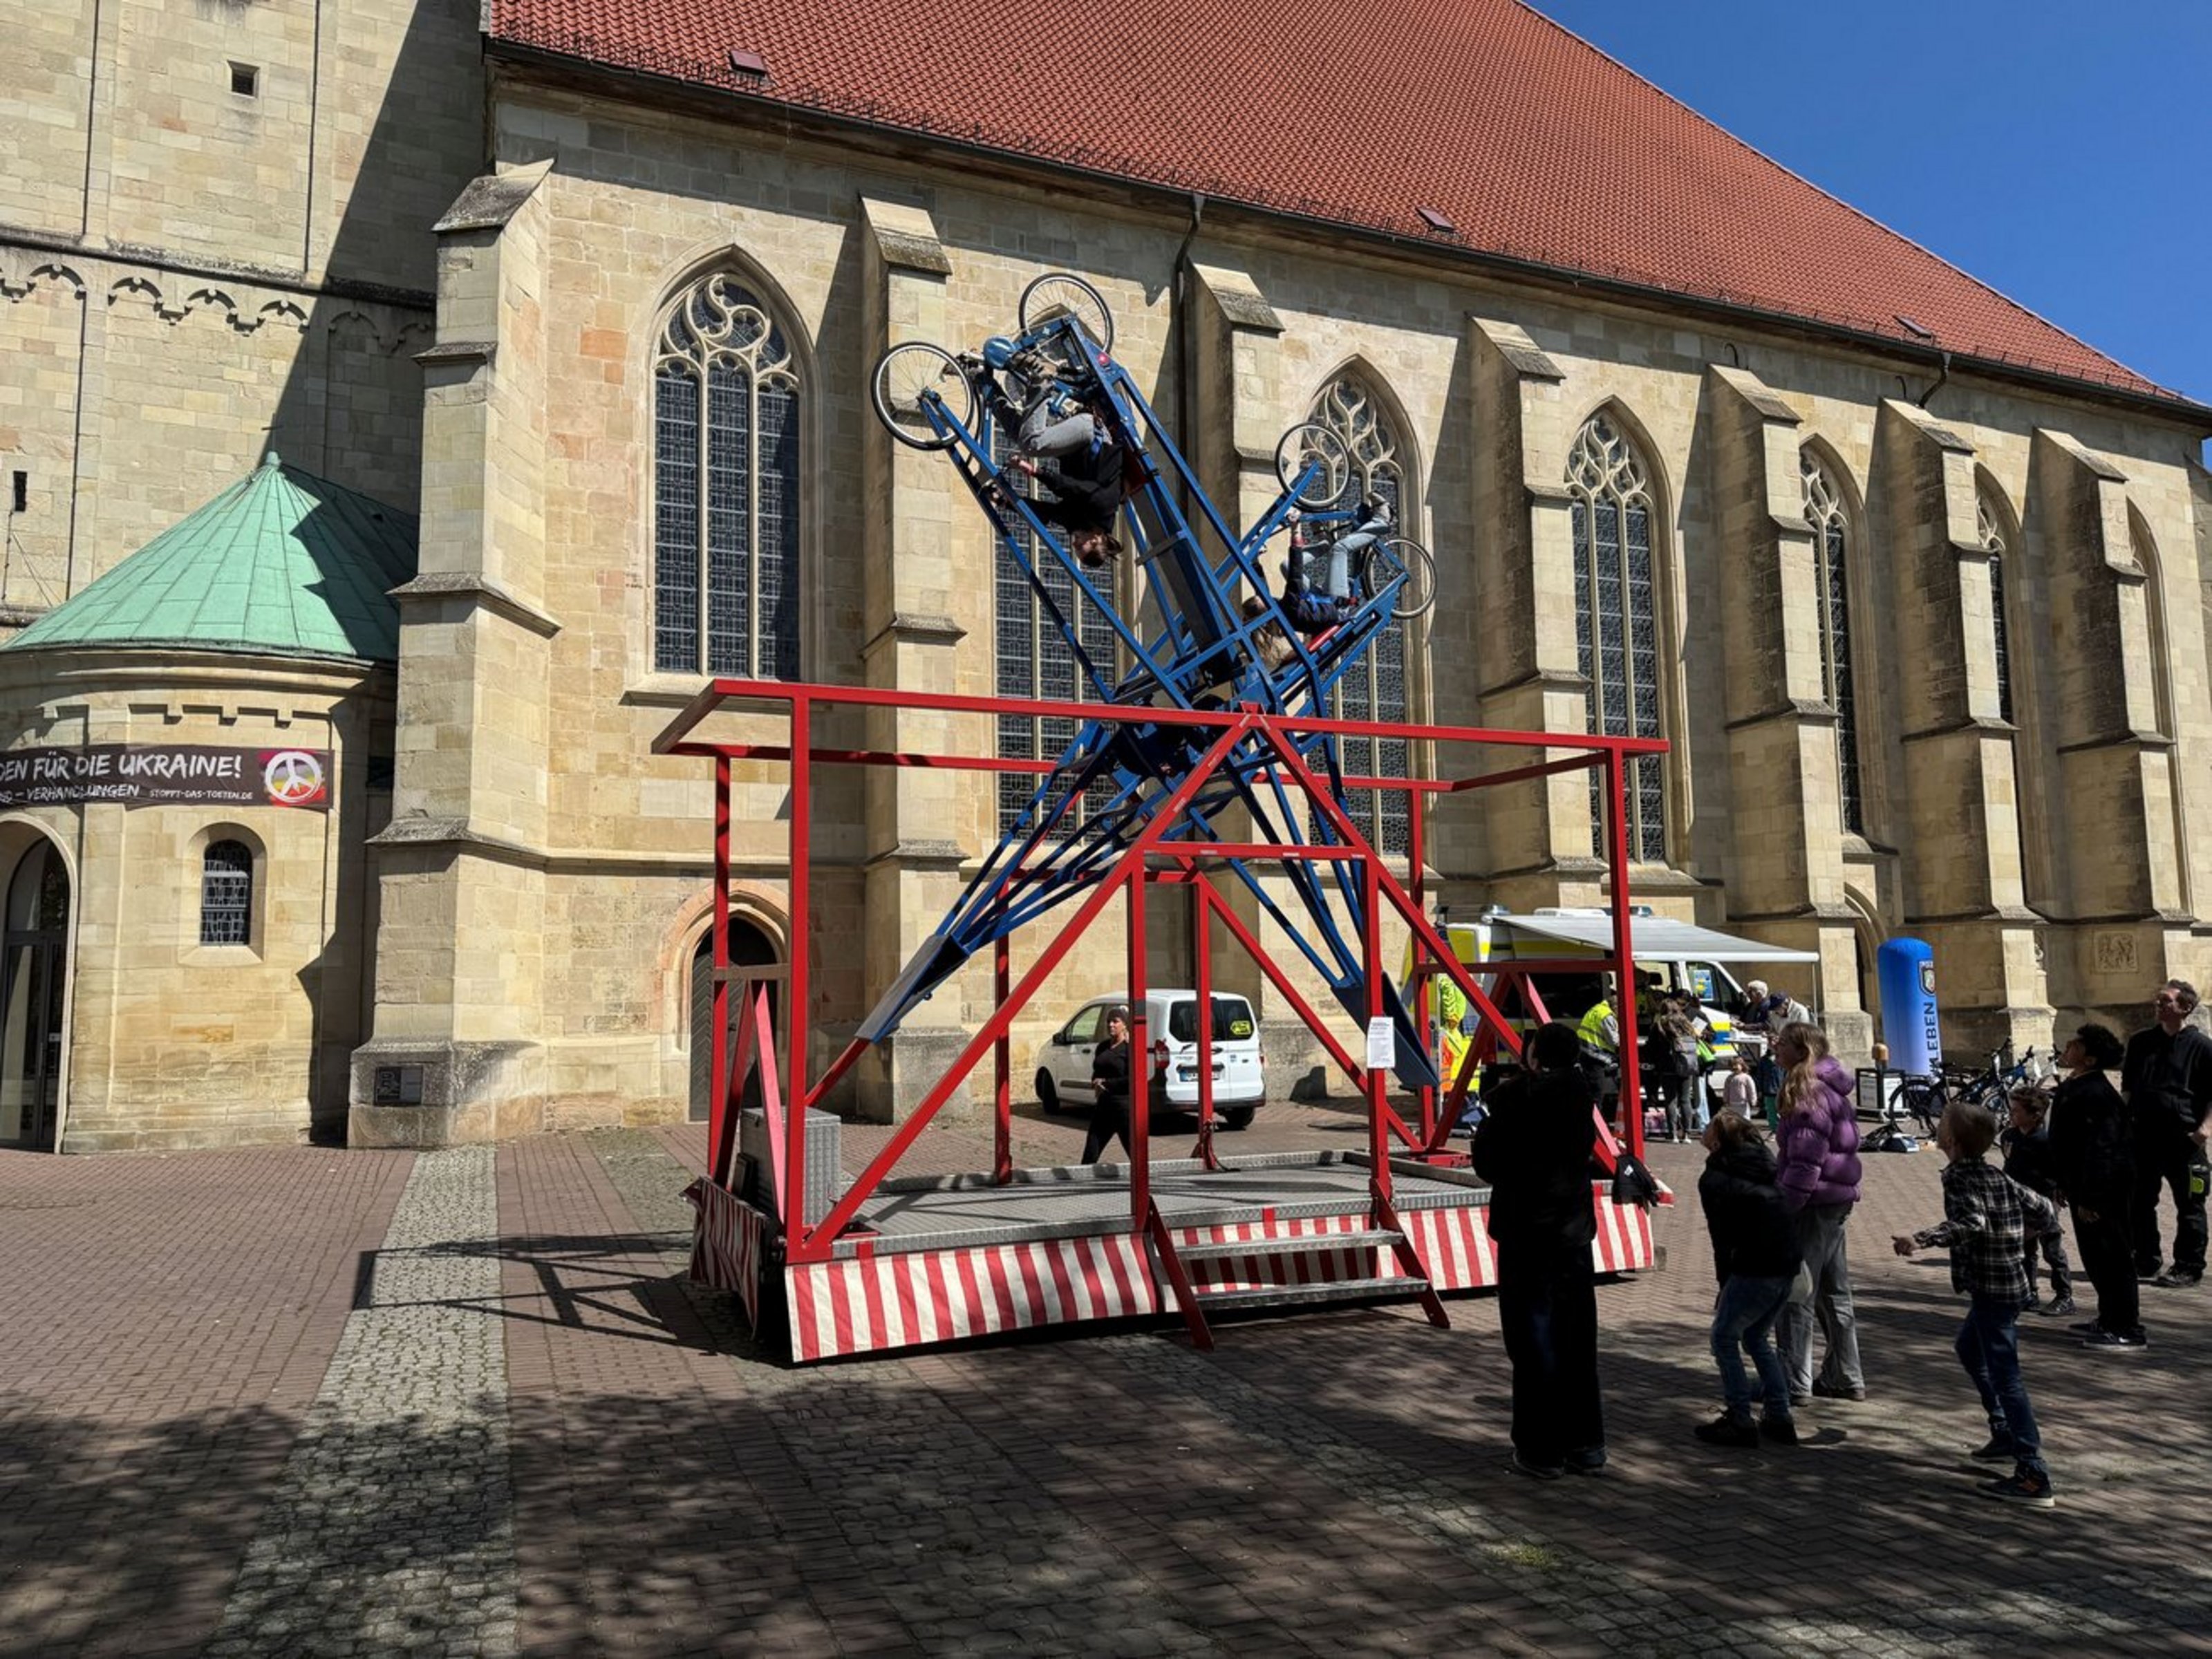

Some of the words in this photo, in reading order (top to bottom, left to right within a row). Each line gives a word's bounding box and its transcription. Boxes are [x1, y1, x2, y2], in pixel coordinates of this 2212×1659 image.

[33, 751, 70, 780] FÜR
[75, 754, 111, 777] DIE
[118, 753, 242, 779] UKRAINE!
